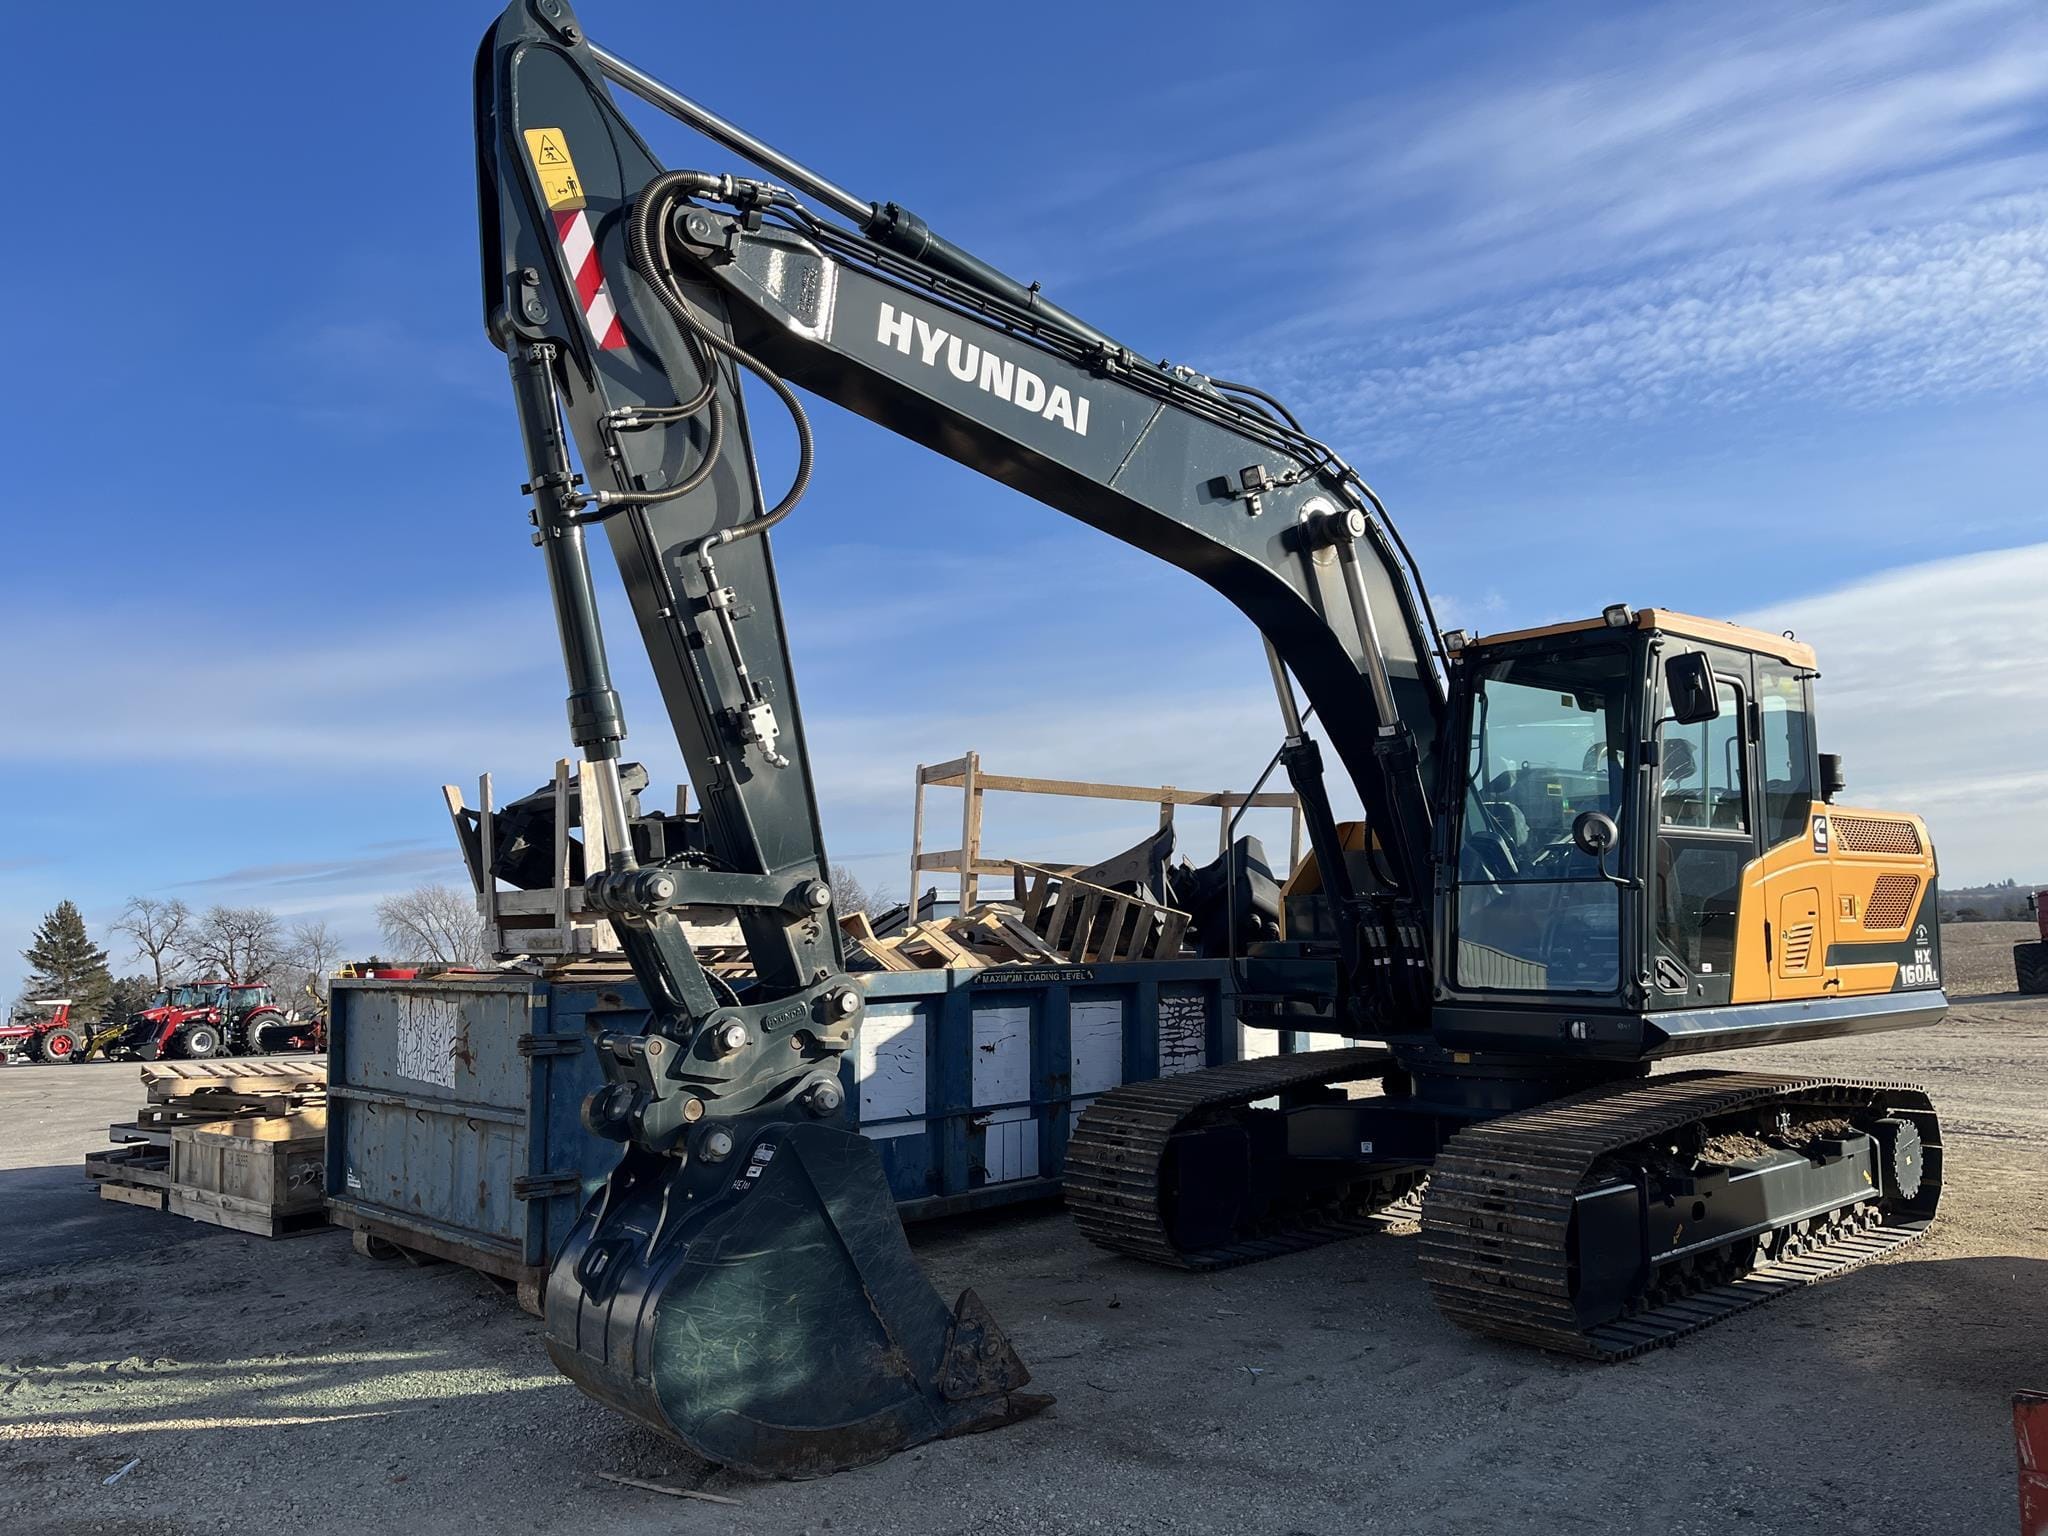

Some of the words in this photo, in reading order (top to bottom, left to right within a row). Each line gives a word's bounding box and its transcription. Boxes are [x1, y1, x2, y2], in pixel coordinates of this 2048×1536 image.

[877, 302, 1089, 436] HYUNDAI
[1915, 949, 1930, 963] HX
[767, 1004, 806, 1026] HYUNDAI
